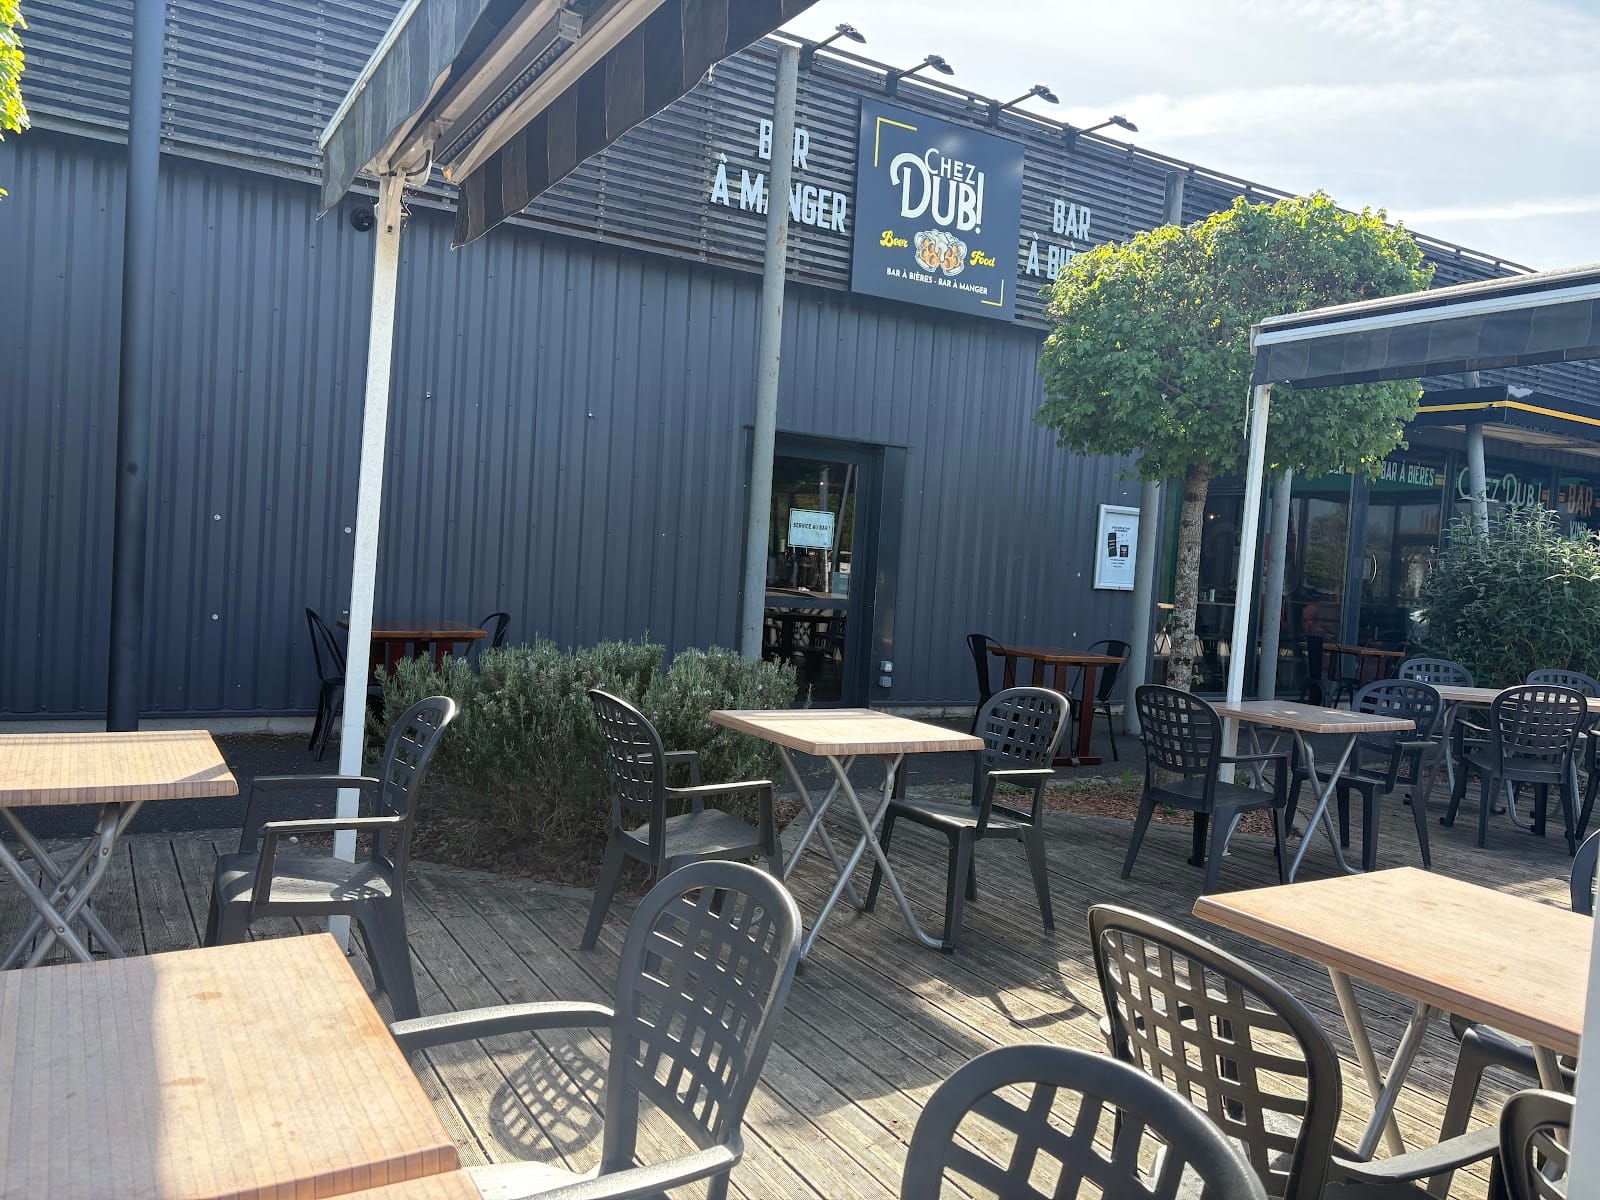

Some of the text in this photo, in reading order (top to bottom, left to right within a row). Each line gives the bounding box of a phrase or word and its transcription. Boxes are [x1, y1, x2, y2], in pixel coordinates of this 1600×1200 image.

[759, 118, 810, 170] BR
[710, 152, 847, 233] À MNGER
[890, 152, 985, 234] DUB!
[880, 230, 909, 248] Beer
[1053, 198, 1091, 242] BAR
[970, 250, 996, 268] Food
[1026, 231, 1040, 277] À
[886, 267, 901, 278] BAR
[902, 268, 908, 279] À
[909, 271, 933, 284] BIÈRES
[938, 278, 952, 288] BAR
[953, 279, 958, 289] À
[959, 283, 988, 295] MANGER
[1381, 460, 1435, 487] BAR À BIÈRES
[1567, 484, 1593, 516] BAR
